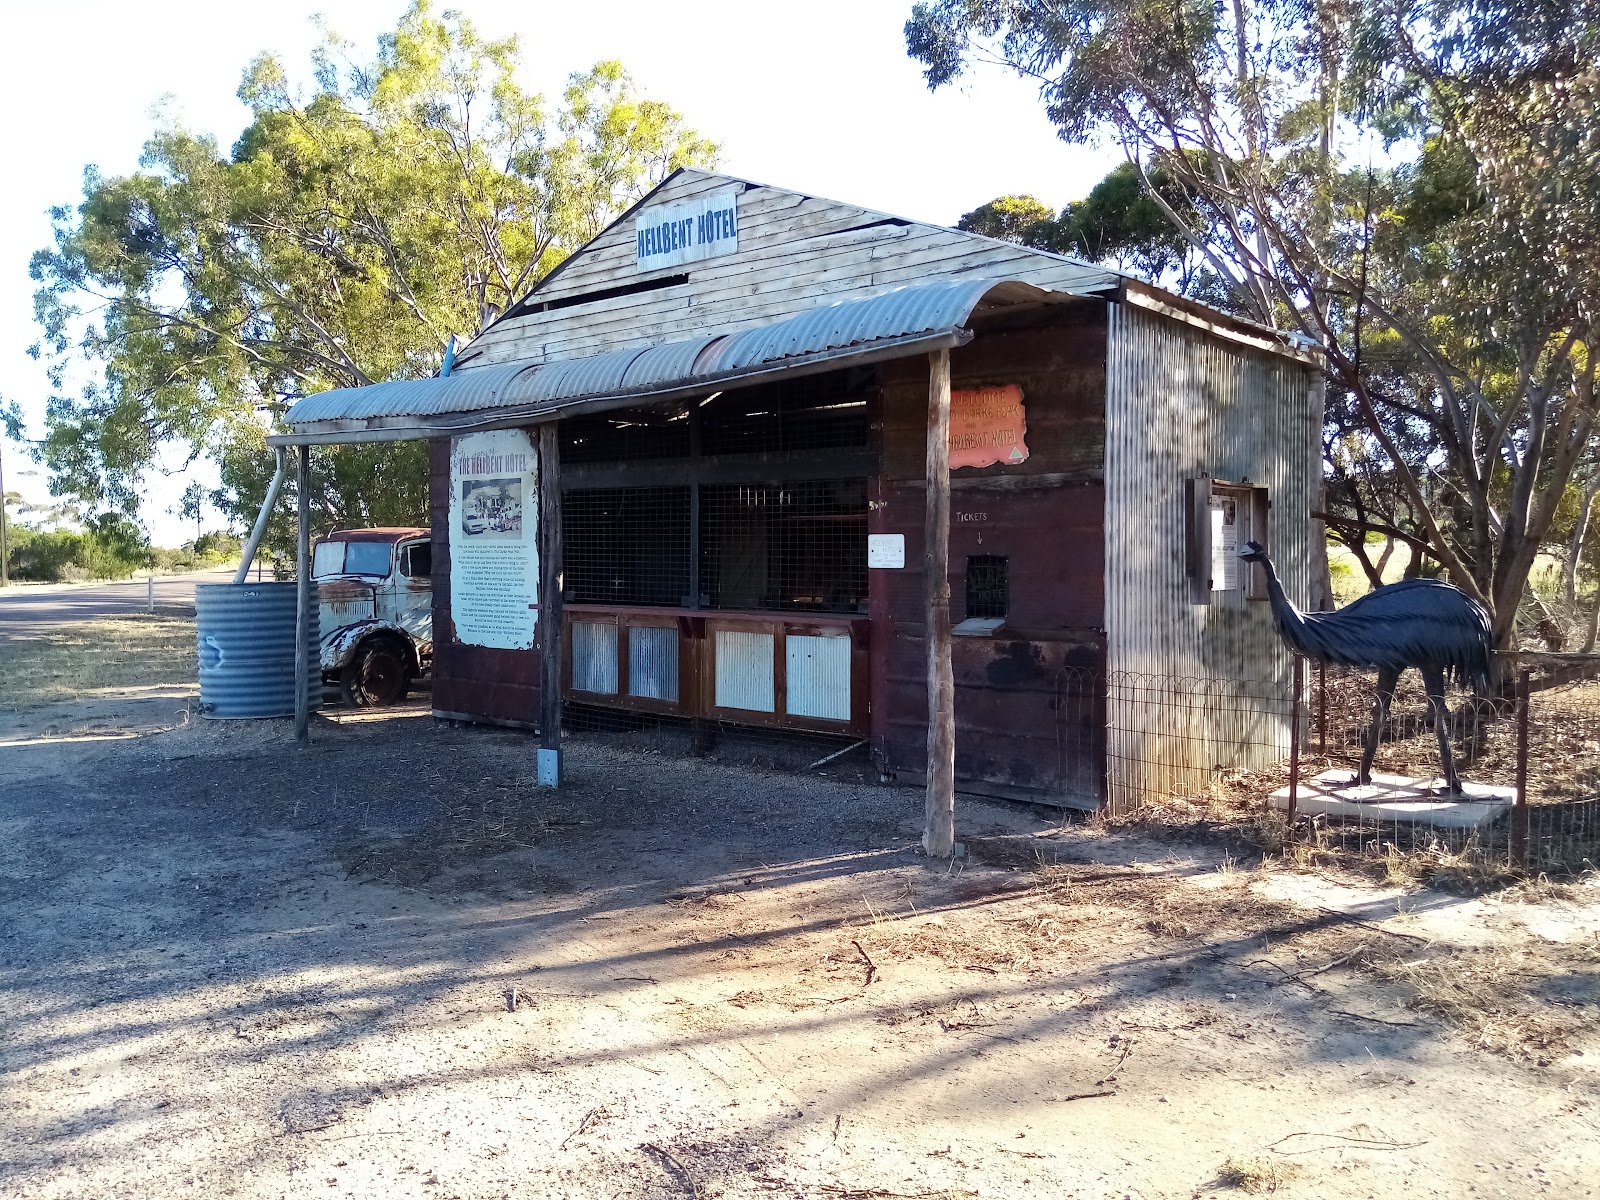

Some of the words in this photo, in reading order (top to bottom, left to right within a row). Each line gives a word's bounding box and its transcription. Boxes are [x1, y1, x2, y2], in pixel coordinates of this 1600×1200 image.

[638, 218, 693, 258] HELLBENT
[698, 208, 736, 244] HOTEL
[951, 390, 1008, 406] WELCOME
[459, 456, 470, 475] THE
[505, 453, 527, 473] HOTEL
[956, 512, 987, 522] TICKETS
